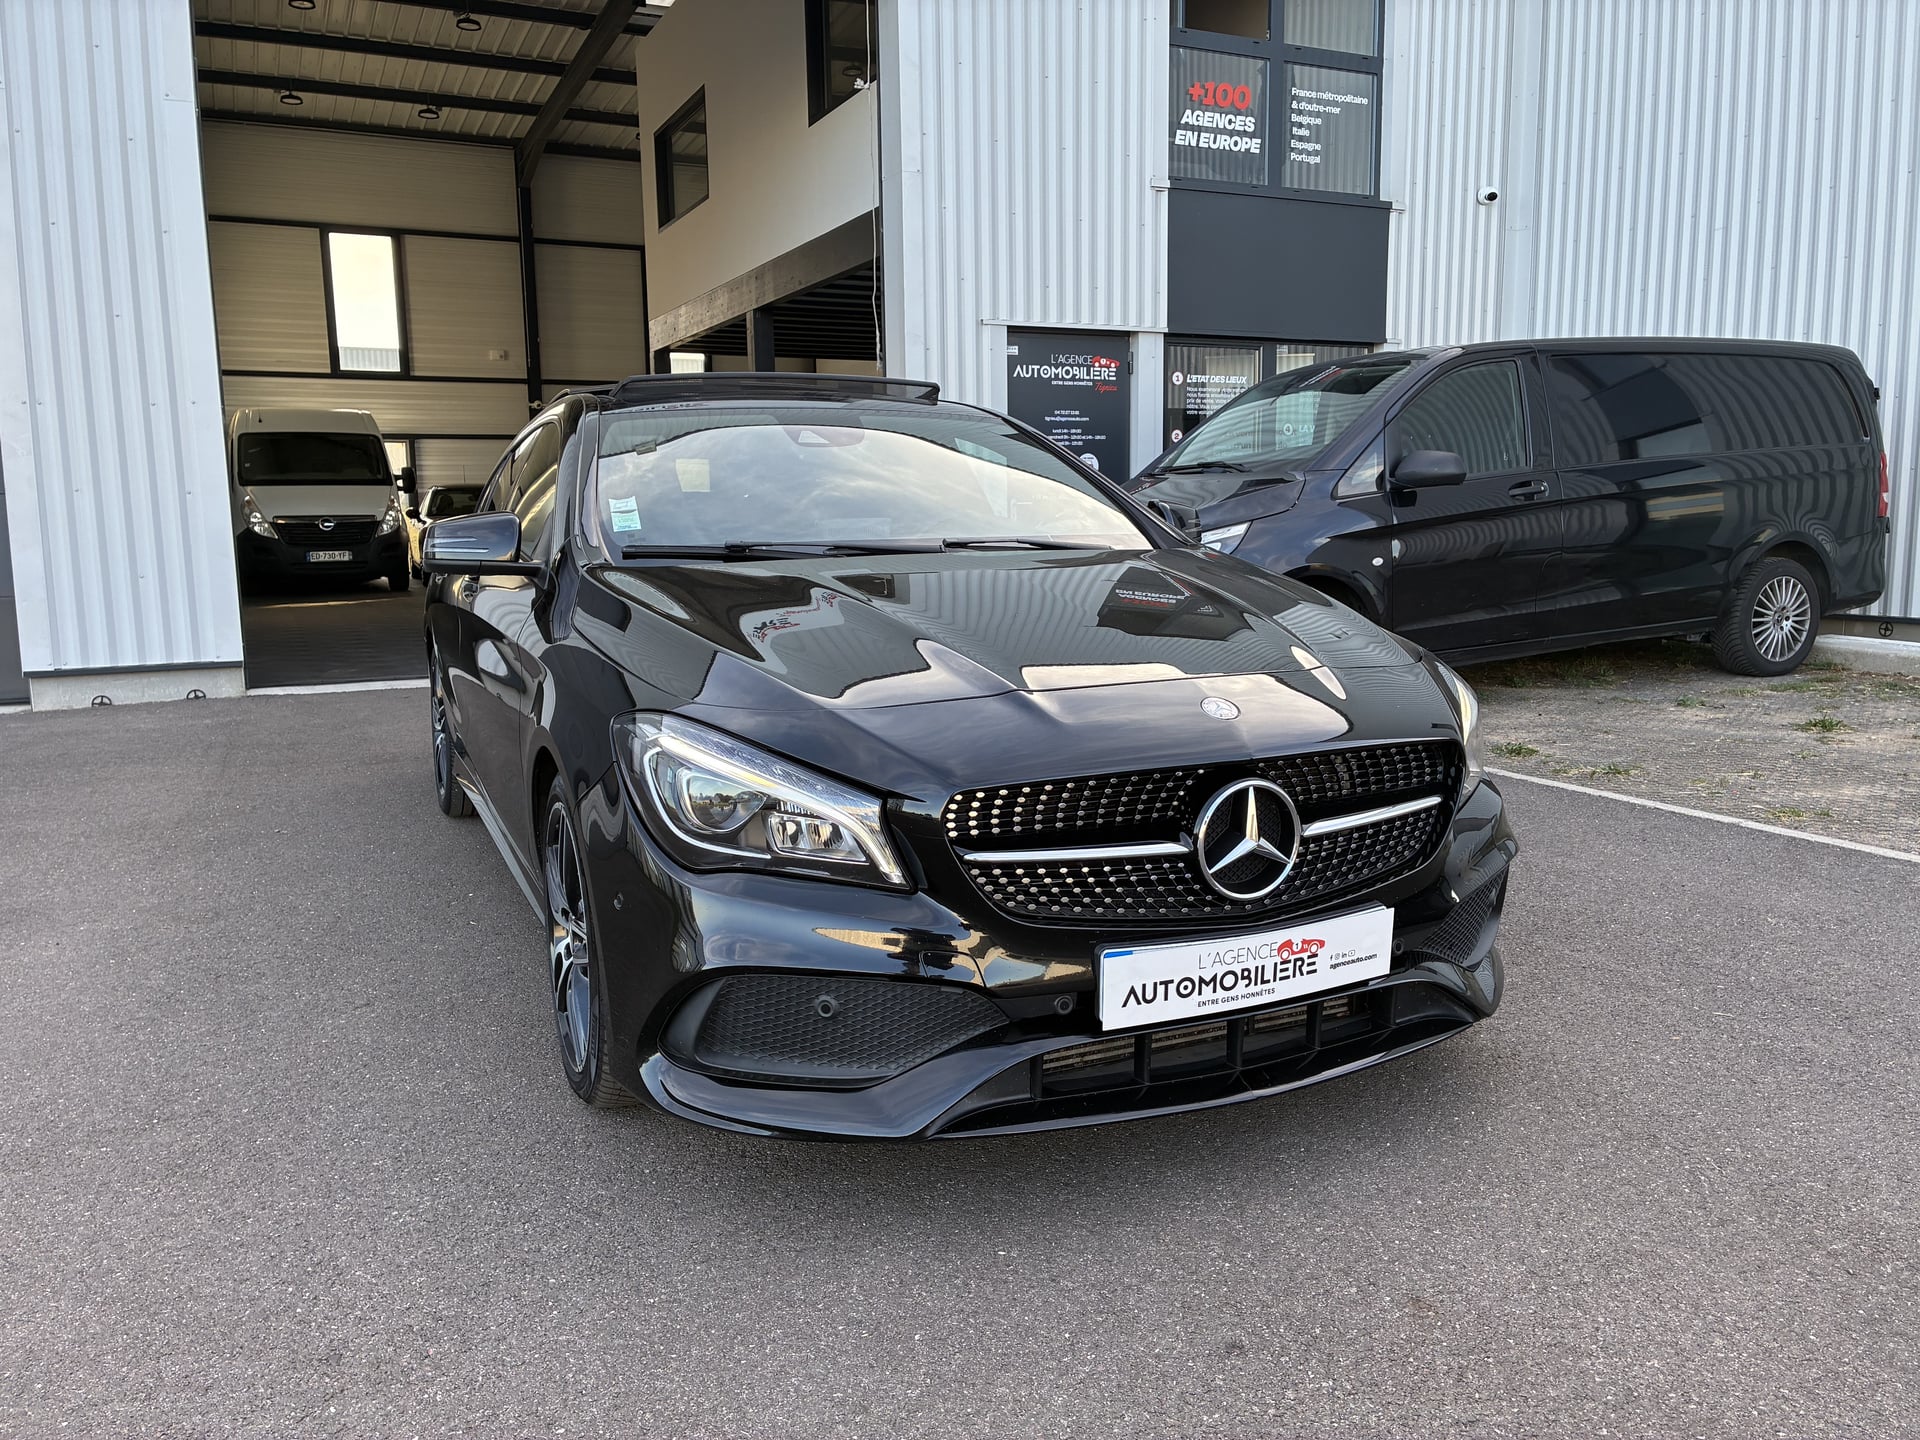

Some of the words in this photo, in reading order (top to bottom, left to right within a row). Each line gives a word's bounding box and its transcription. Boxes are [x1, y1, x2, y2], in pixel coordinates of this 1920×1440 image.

[1188, 81, 1252, 110] +100
[1291, 87, 1316, 99] France
[1317, 89, 1368, 105] métropolitaine
[1291, 100, 1299, 109] &
[1299, 101, 1341, 115] d'outre-mer
[1180, 109, 1255, 132] AGENCES
[1291, 113, 1322, 126] Belgique
[1292, 126, 1310, 137] Italie
[1174, 129, 1198, 147] EN
[1198, 132, 1262, 154] EUROPE
[1290, 139, 1322, 153] Espagne
[1290, 152, 1321, 165] Portugal
[1051, 354, 1093, 365] L'AGENCE
[1186, 374, 1210, 383] L'ETAT
[1210, 375, 1226, 383] DES
[1226, 376, 1247, 384] LIEUX
[1197, 941, 1279, 970] L'AGENCE
[1329, 953, 1378, 970] agenceauto.com
[1197, 996, 1220, 1008] ENTRE
[1220, 994, 1240, 1004] GENS
[1241, 987, 1276, 1001] HONNÊTES
